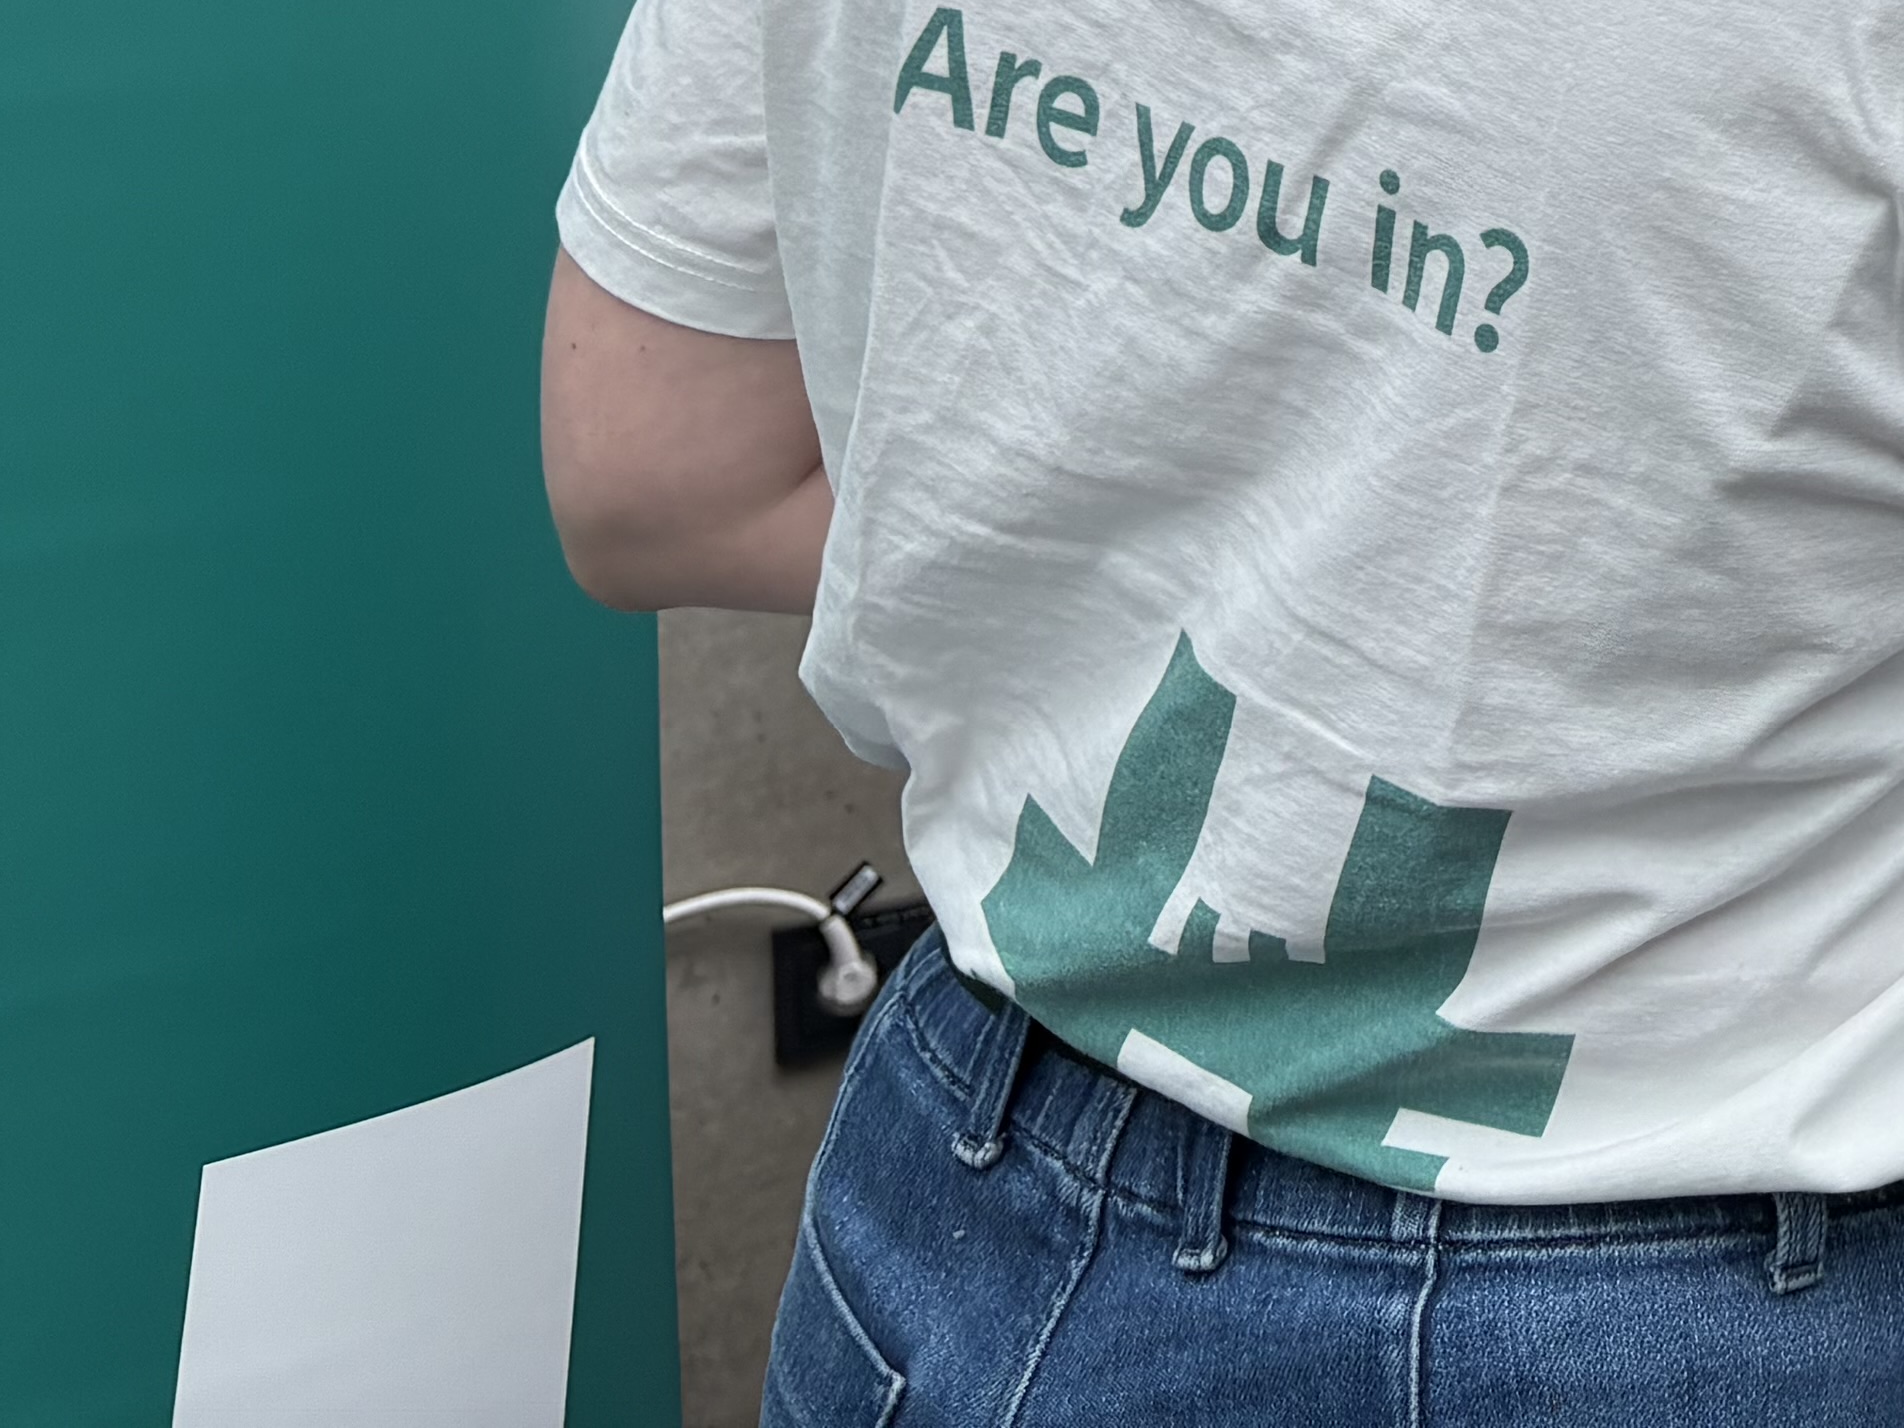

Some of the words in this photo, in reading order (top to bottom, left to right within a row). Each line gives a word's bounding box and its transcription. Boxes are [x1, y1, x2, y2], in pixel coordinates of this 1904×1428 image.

[893, 6, 1099, 169] Are
[1119, 102, 1330, 268] you
[1370, 169, 1530, 354] in?
